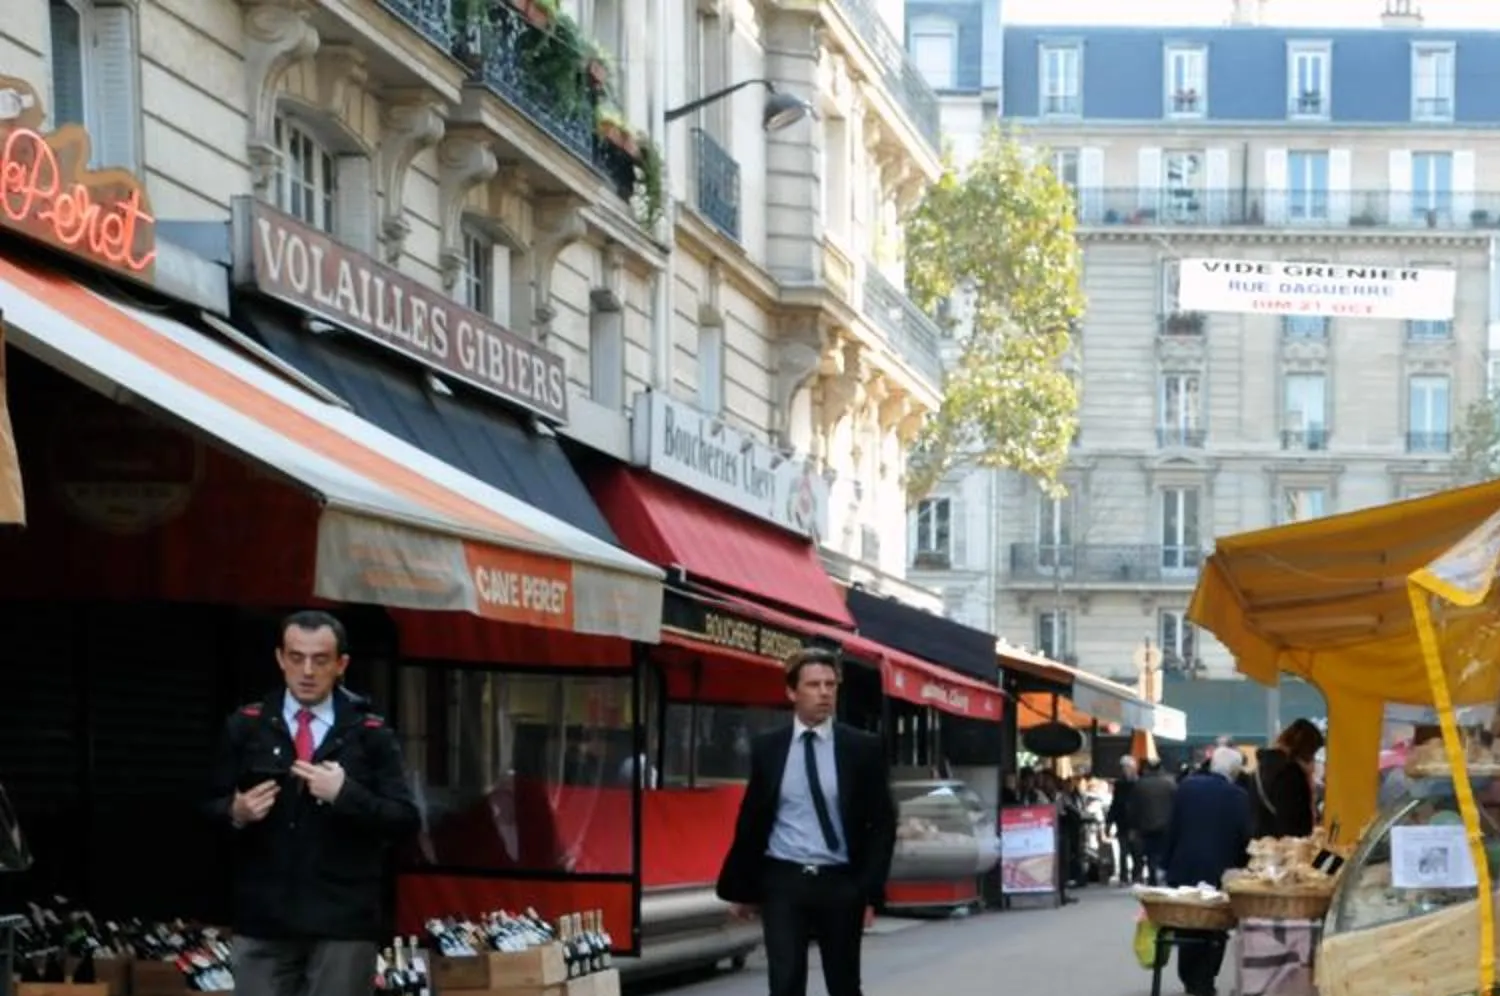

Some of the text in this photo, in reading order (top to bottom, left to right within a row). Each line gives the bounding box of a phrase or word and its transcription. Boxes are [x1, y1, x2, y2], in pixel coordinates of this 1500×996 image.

[1202, 261, 1420, 282] VIDE GRENIER
[1228, 279, 1396, 297] RUE DAGUERRE
[258, 217, 565, 410] VOLAILLES GIBIERS
[475, 566, 520, 608] CAVE
[521, 575, 569, 614] PERET
